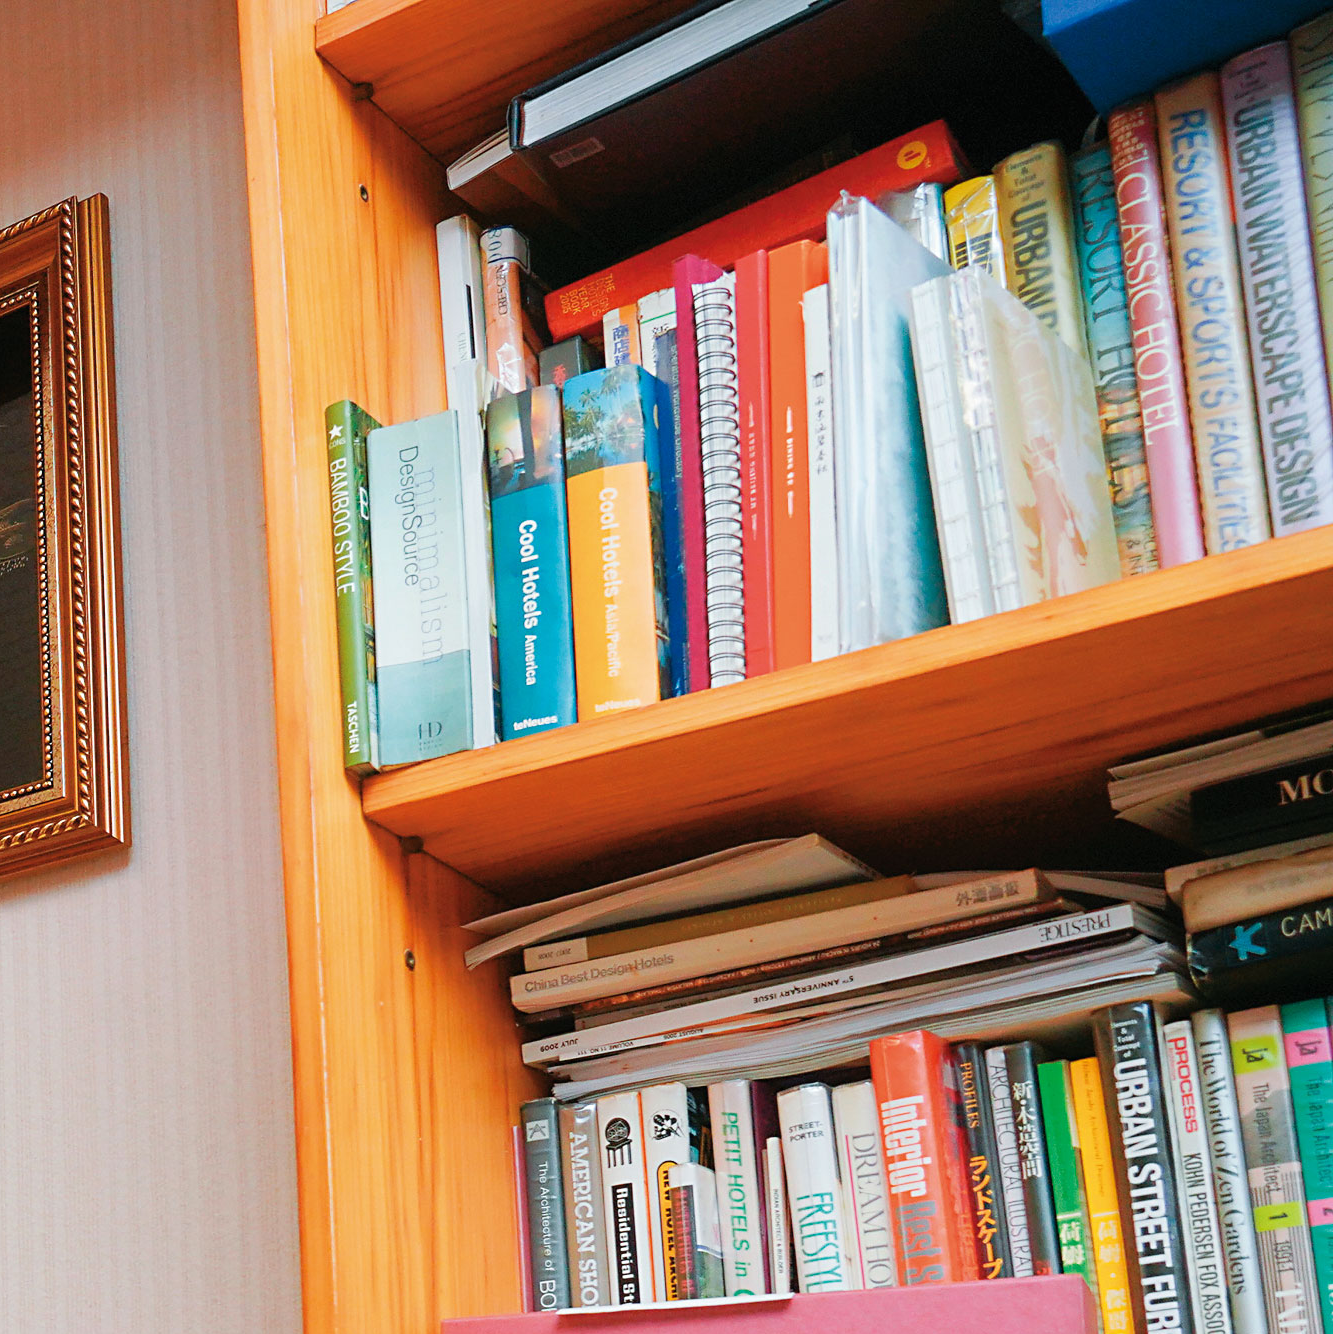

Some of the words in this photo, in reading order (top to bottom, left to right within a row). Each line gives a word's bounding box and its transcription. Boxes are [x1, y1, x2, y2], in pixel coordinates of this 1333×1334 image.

[1170, 108, 1218, 234] RESORT
[1232, 101, 1284, 210] URBAN
[1009, 199, 1055, 310] URBAN
[1117, 173, 1164, 319] CLASSIC
[569, 289, 581, 315] BOOK
[578, 285, 589, 310] YEAR
[1245, 211, 1306, 414] WATERSCAPE
[1186, 275, 1238, 409] SPORTS
[1134, 320, 1178, 444] HOTEL
[1206, 417, 1252, 554] FACILITIES
[1270, 412, 1320, 526] DESIGN
[329, 458, 352, 537] BAMBOO
[394, 445, 424, 587] DesignSource
[599, 488, 617, 534] Cool
[335, 538, 355, 597] STYLE
[413, 467, 445, 665] minimalism
[518, 520, 537, 564] Cool
[601, 535, 621, 598] Hotels
[521, 565, 543, 630] Hotels
[525, 635, 538, 686] America
[603, 604, 622, 677] Asia/Pacific
[345, 701, 360, 753] TASCHEN
[513, 715, 558, 731] teNeues
[595, 697, 641, 713] teNeues
[1039, 913, 1111, 943] PRESTIGE
[524, 972, 560, 992] China
[560, 968, 589, 985] Best
[590, 959, 632, 981] Design
[635, 953, 674, 971] Hotels
[753, 993, 777, 1004] ISSUE
[779, 978, 840, 999] ANNIVERSARY
[540, 1043, 559, 1053] 2009
[560, 1038, 579, 1050] JULY
[609, 1041, 634, 1051] VOLUME
[679, 1028, 704, 1038] AUGUST
[1198, 1031, 1223, 1076] The
[1242, 1046, 1269, 1063] ja
[1294, 1040, 1322, 1057] ja
[960, 1062, 980, 1129] PROFILES
[1114, 1057, 1158, 1159] URBAN
[1168, 1036, 1199, 1134] PROCESS
[1202, 1076, 1231, 1131] World
[1252, 1081, 1270, 1104] The
[722, 1112, 742, 1167] PETIT
[788, 1120, 823, 1134] STREET-
[789, 1130, 824, 1142] PORTER
[881, 1095, 932, 1198] Interior
[989, 1065, 1021, 1194] ARCHITECTURAL
[1254, 1106, 1274, 1139] Japan
[537, 1161, 549, 1183] The
[569, 1131, 596, 1252] AMERICAN
[851, 1132, 883, 1235] DREAM
[1183, 1153, 1207, 1189] KOHN
[1216, 1166, 1239, 1205] Zen
[1259, 1141, 1282, 1193] Architect
[539, 1185, 552, 1256] Architecture
[615, 1187, 633, 1282] Residential
[727, 1175, 750, 1251] HOTELS
[896, 1200, 942, 1261] Best
[969, 1155, 1004, 1279] ランドスケープ
[1127, 1163, 1174, 1268] STREET
[1188, 1191, 1215, 1262] PEDERSEN
[544, 1259, 554, 1271] of
[735, 1262, 751, 1277] in
[1199, 1264, 1219, 1291] FOX
[1220, 1210, 1253, 1296] Gardens
